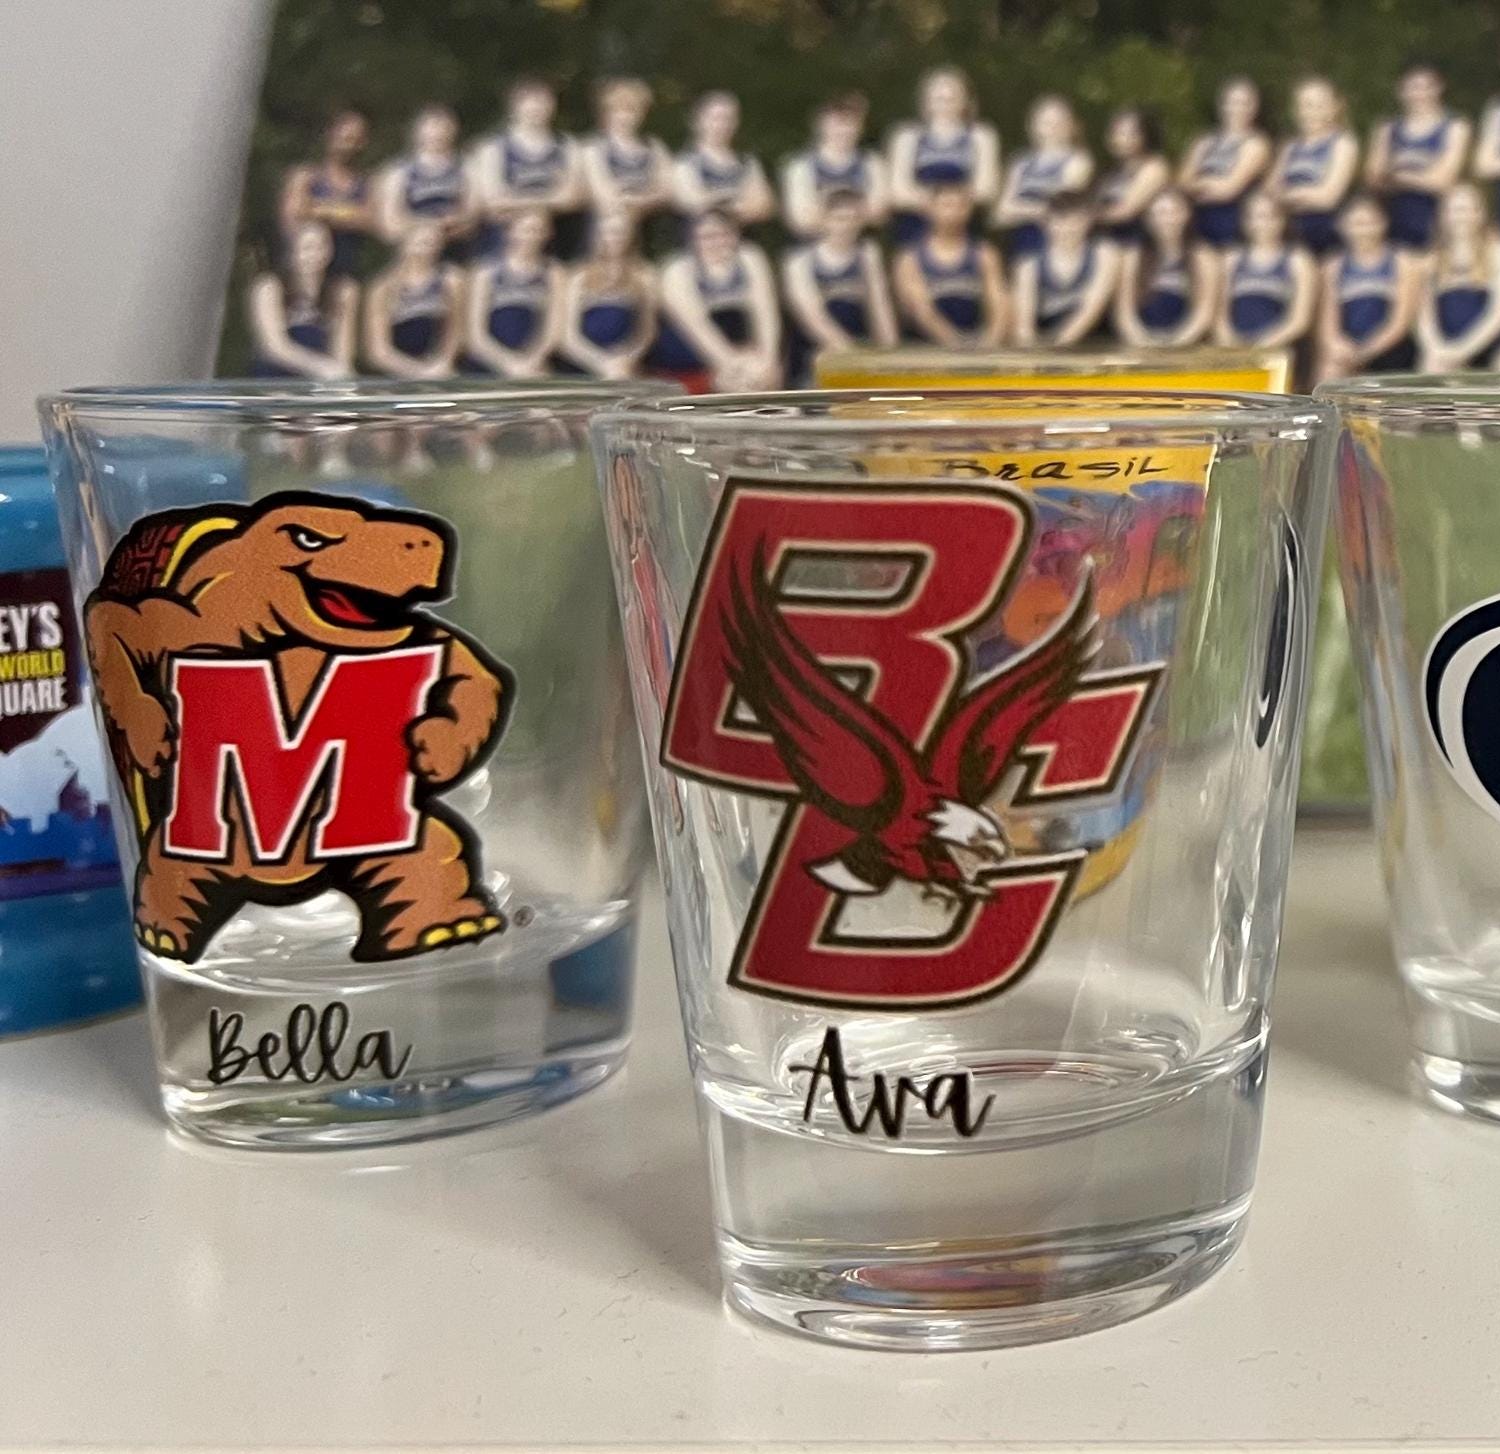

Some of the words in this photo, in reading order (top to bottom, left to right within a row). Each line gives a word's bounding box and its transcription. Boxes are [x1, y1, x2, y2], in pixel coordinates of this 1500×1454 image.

[160, 645, 444, 863] M
[207, 1001, 413, 1084] Bella
[788, 1025, 995, 1138] Ava
